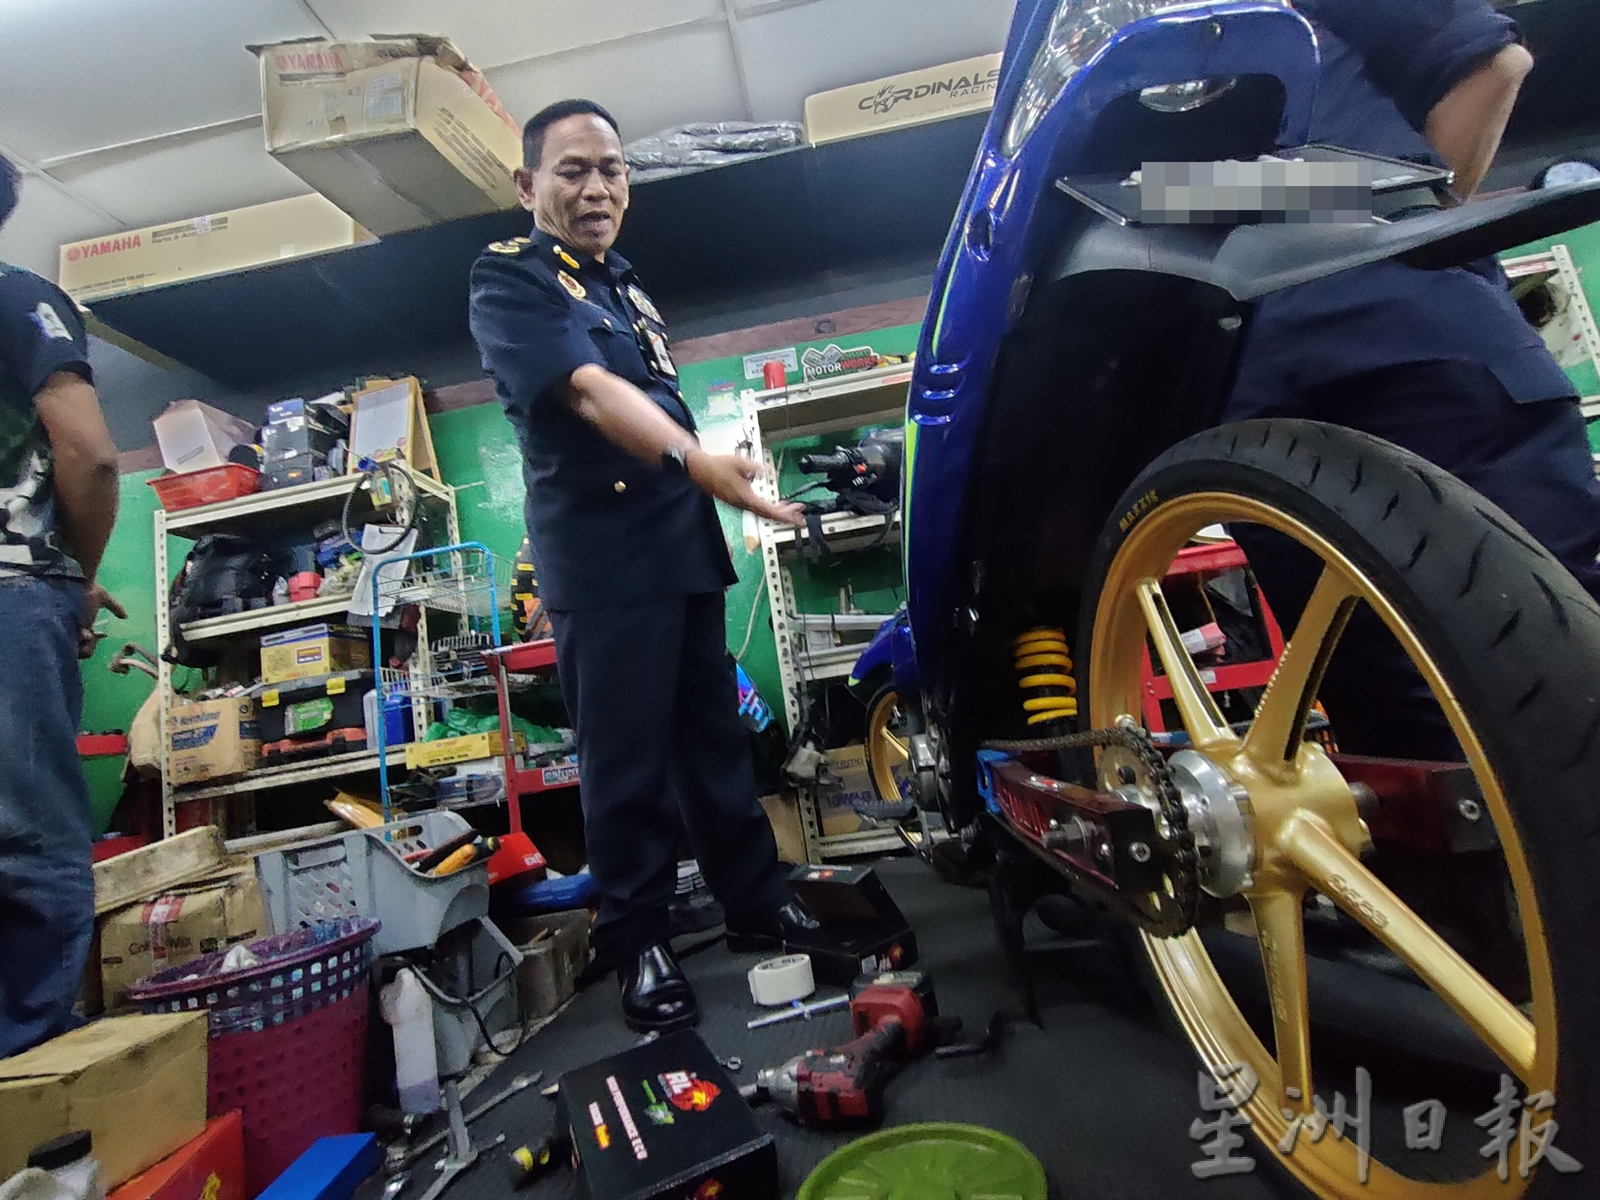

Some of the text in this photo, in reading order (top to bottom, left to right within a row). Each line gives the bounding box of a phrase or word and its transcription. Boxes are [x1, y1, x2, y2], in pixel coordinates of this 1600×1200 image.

[949, 82, 996, 98] RACIN
[952, 95, 994, 108] PERFORMAN
[81, 235, 142, 258] YAMAHA
